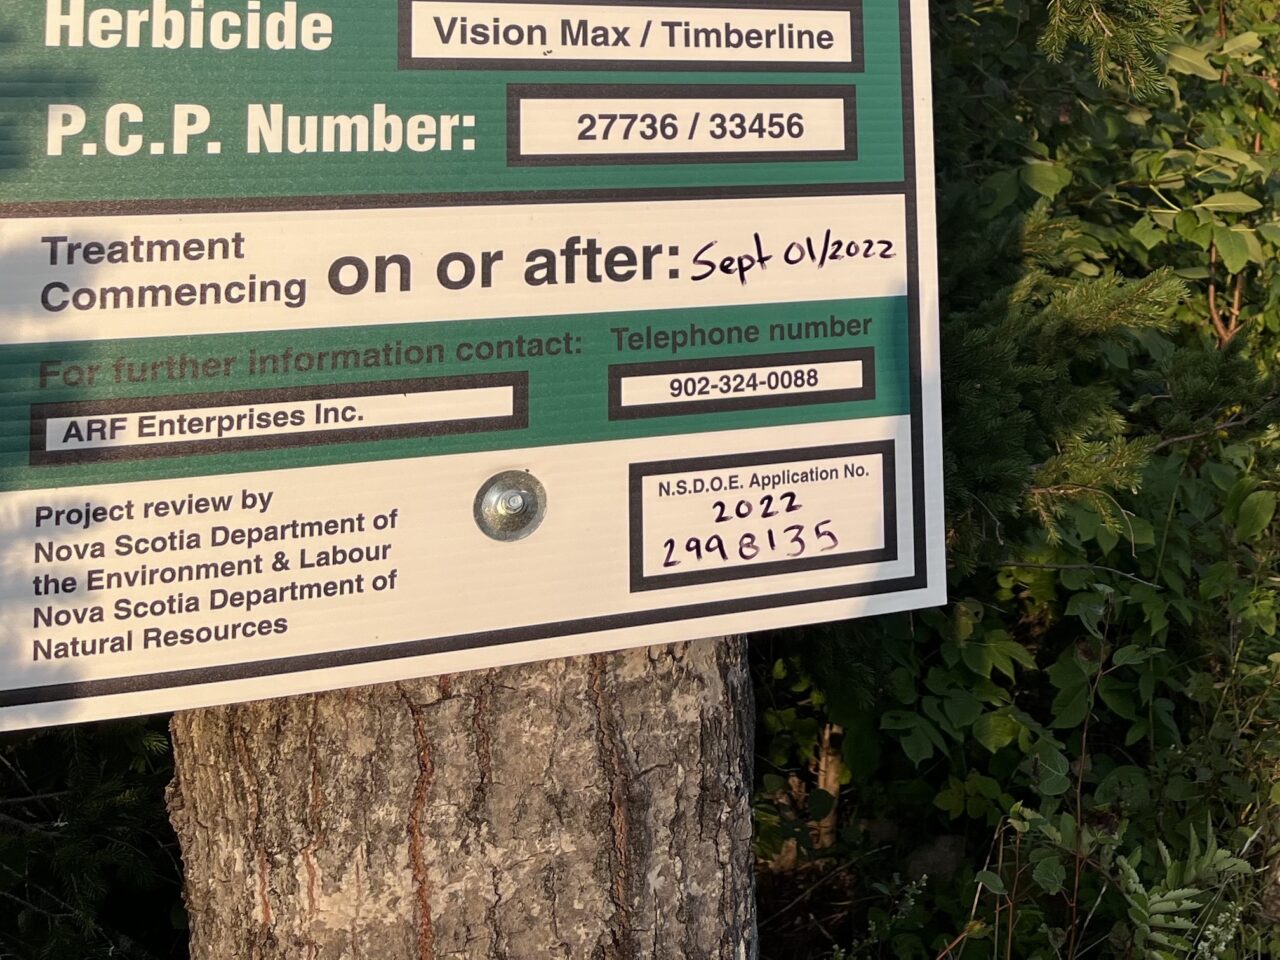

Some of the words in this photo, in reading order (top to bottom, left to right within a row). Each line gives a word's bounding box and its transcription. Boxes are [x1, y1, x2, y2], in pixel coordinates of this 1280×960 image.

[433, 17, 546, 45] Vision
[561, 19, 630, 46] Max
[640, 21, 652, 47] /
[661, 21, 833, 49] Timberline
[47, 103, 221, 156] P.C.P.
[247, 104, 475, 153] Number:
[578, 114, 678, 140] 27736
[688, 113, 699, 140] /
[710, 113, 803, 139] 33456
[41, 233, 244, 266] Treatment
[328, 253, 411, 295] on
[436, 250, 503, 290] or
[525, 236, 679, 286] after:
[40, 274, 307, 312] Commencing
[611, 324, 759, 353] Telephone
[770, 315, 872, 341] number
[38, 360, 99, 388] For
[112, 353, 236, 384] further
[456, 332, 581, 361] contact:
[670, 369, 818, 397] 902-324-0088
[62, 418, 126, 443] ARF
[138, 408, 305, 437] Enterprises
[316, 404, 363, 424] Inc.
[659, 475, 743, 496] N.S.D.O.E.
[749, 467, 838, 490] Application
[844, 464, 869, 478] No.
[36, 501, 133, 529] Project
[144, 494, 232, 518] review
[242, 490, 273, 513] by
[35, 541, 104, 563] Nova
[115, 530, 200, 556] Scotia
[212, 514, 364, 548] Department
[373, 509, 397, 530] of
[33, 575, 76, 596] the
[87, 555, 262, 591] Environment
[272, 551, 290, 571] &
[301, 544, 391, 568] Labour
[34, 606, 103, 628] Nova
[114, 593, 199, 620] Scotia
[210, 575, 364, 611] Department
[372, 569, 397, 591] of
[33, 631, 133, 661] Natural
[144, 618, 287, 649] Resources
